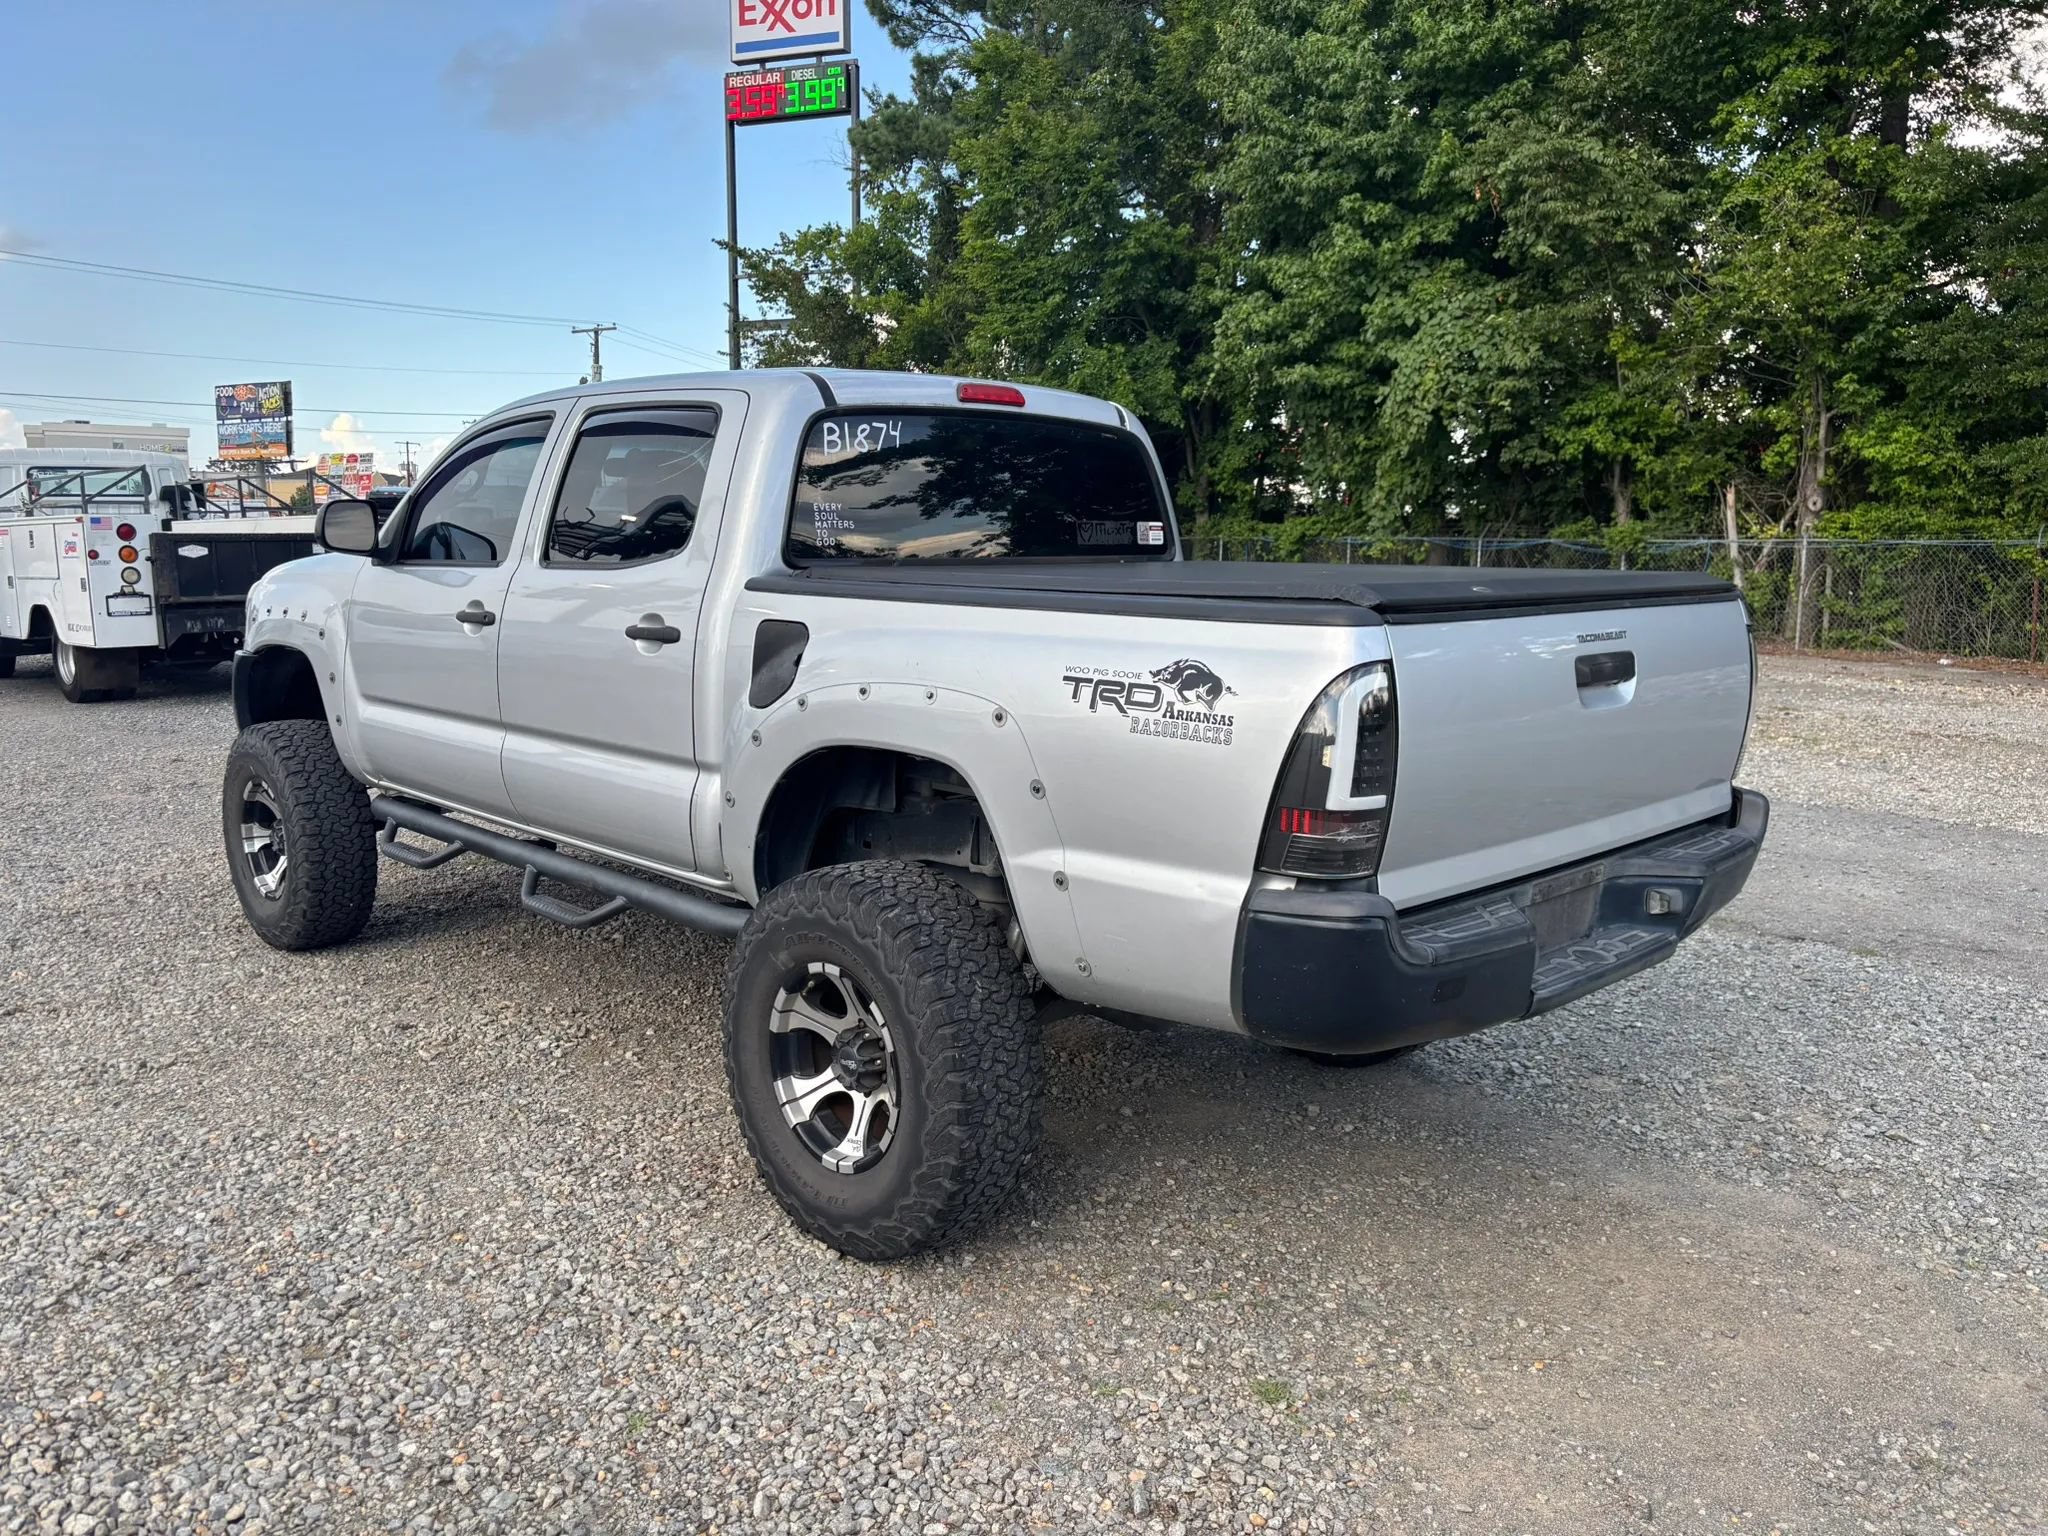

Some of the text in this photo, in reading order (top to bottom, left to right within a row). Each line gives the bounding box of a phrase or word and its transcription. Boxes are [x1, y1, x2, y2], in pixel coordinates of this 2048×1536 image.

[729, 72, 781, 88] REGULAR
[791, 67, 818, 81] DIESEL
[822, 420, 902, 457] B1874
[813, 503, 842, 512] EVERY
[814, 512, 840, 521] SOUL
[815, 520, 855, 529] MATTERS
[816, 529, 828, 538] TO
[816, 537, 836, 546] GOD
[1576, 630, 1627, 643] TACOMABEAST
[1065, 665, 1144, 680] WOO PIG SOOIE
[1062, 675, 1165, 718] TRD
[1129, 716, 1234, 746] RAZORBACKS
